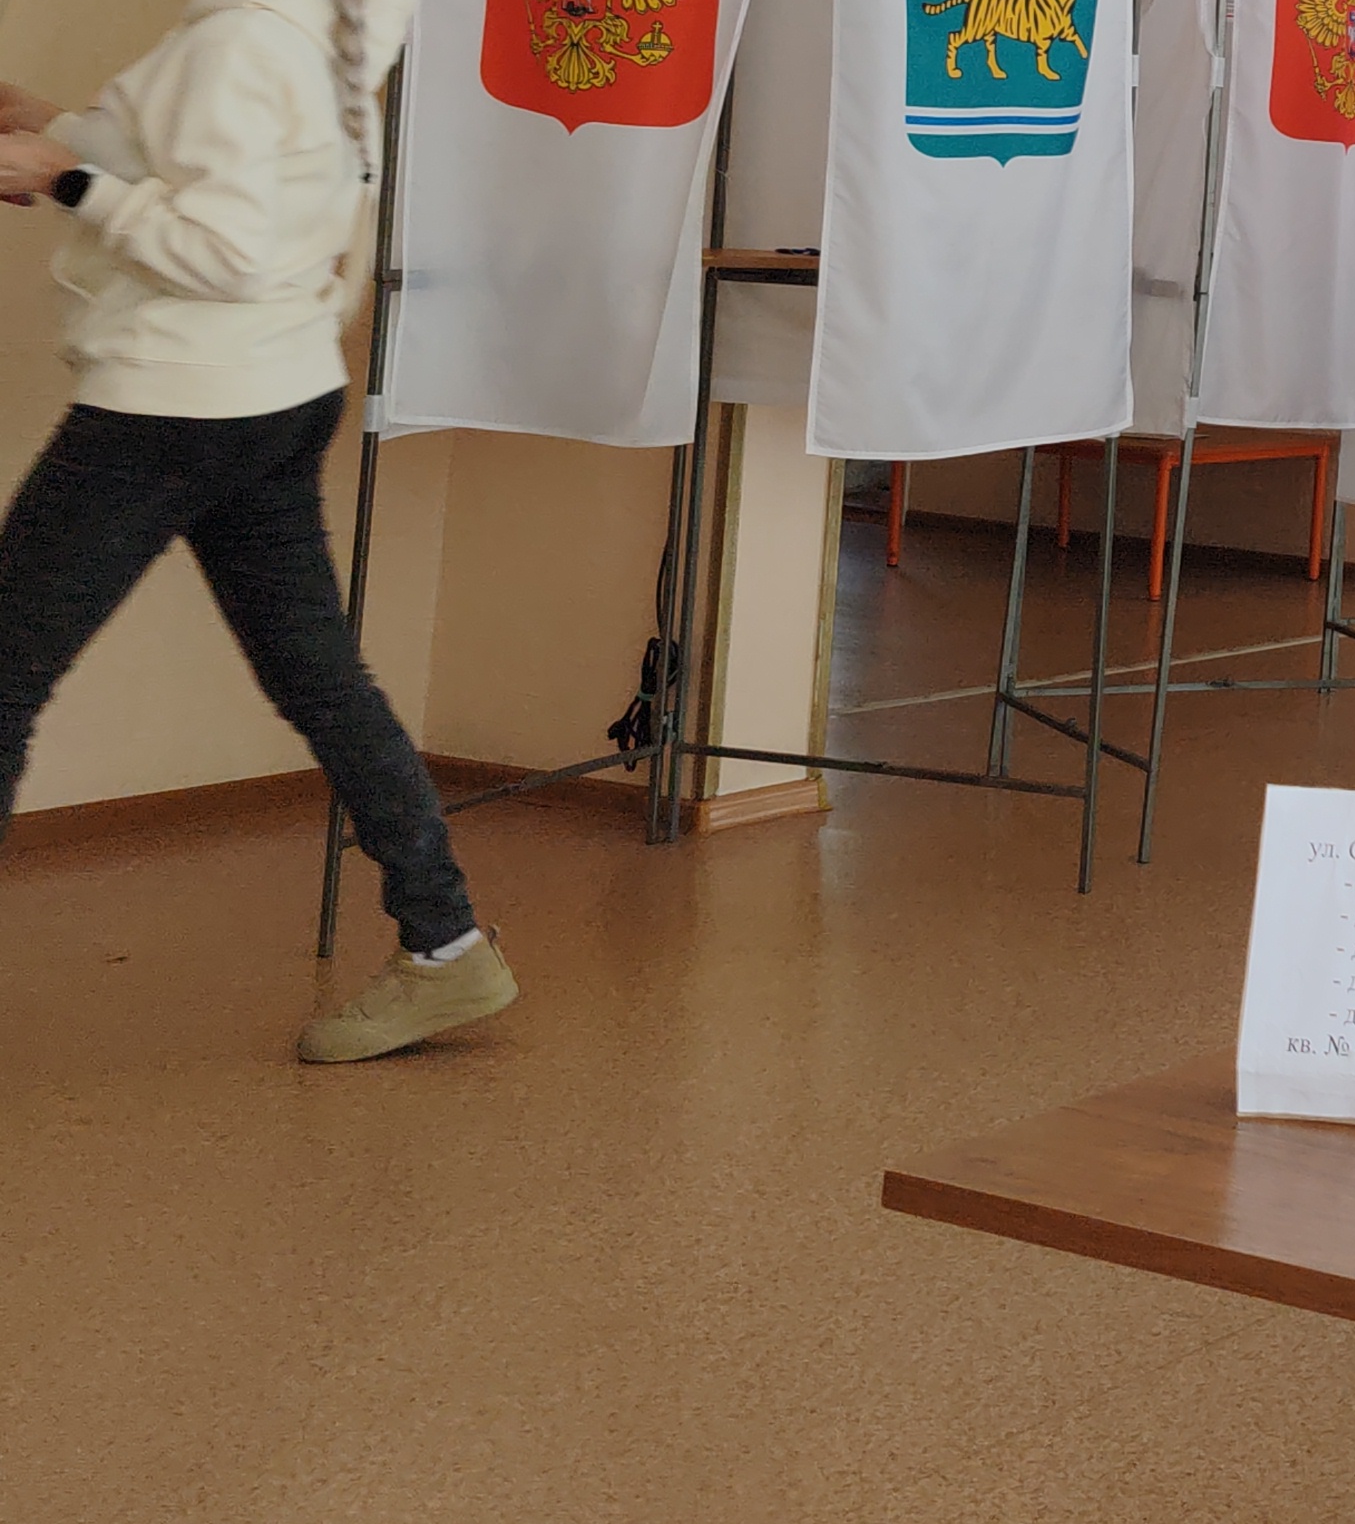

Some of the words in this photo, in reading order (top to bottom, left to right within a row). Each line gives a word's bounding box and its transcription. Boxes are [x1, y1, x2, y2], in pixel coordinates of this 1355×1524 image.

[1308, 842, 1340, 862] ул.
[1286, 1037, 1316, 1055] кв.
[1324, 1034, 1350, 1057] №
